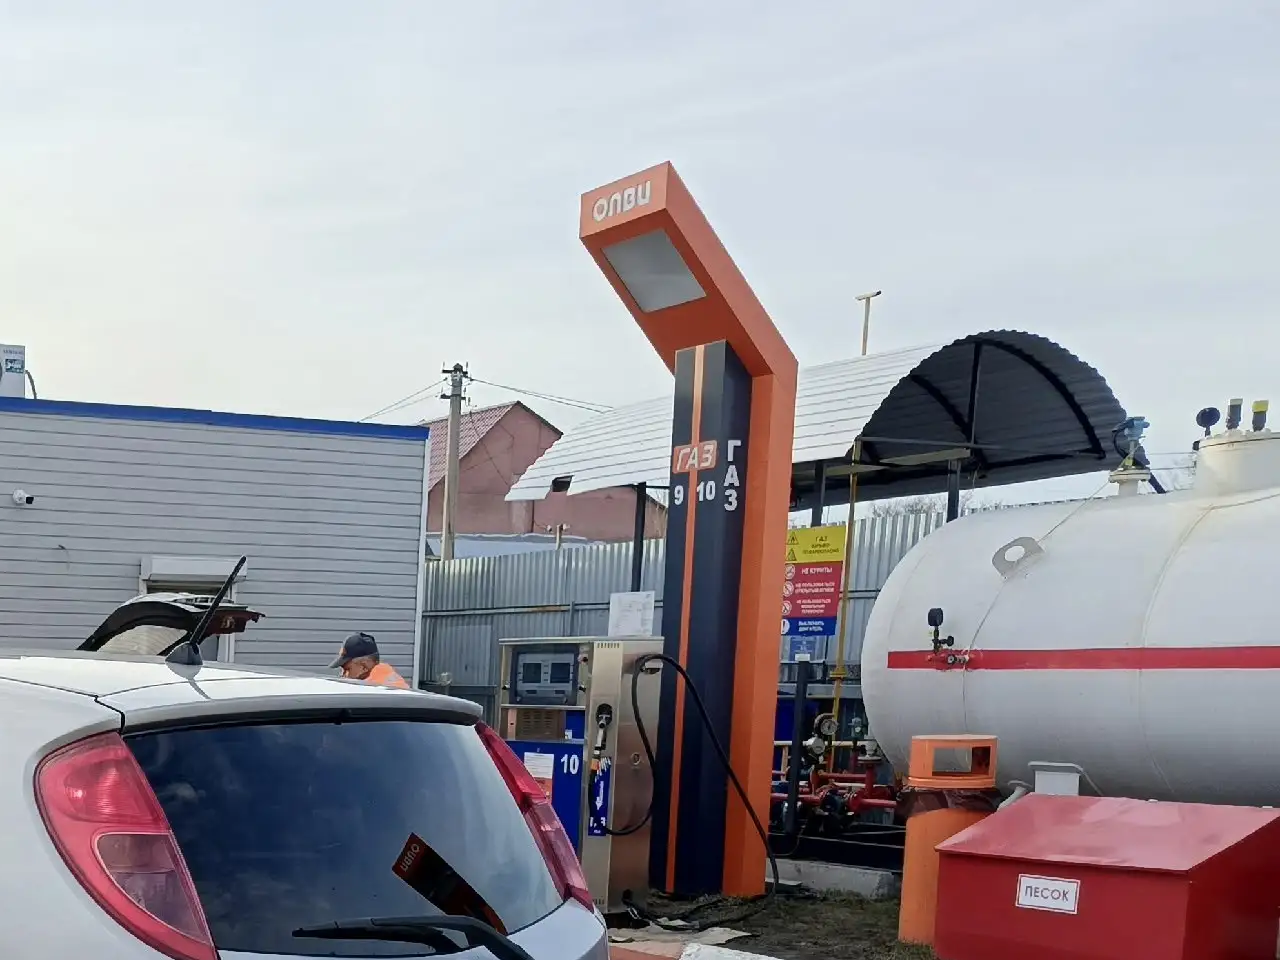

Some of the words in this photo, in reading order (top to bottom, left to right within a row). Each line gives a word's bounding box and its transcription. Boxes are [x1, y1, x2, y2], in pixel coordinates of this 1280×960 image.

[592, 180, 651, 222] ОЛВИ
[676, 444, 714, 471] ГАЗ
[723, 439, 741, 511] ГАЗ
[674, 485, 684, 506] 9
[696, 480, 716, 501] 10
[560, 754, 579, 774] 10
[1025, 885, 1070, 902] ПЕСОК
